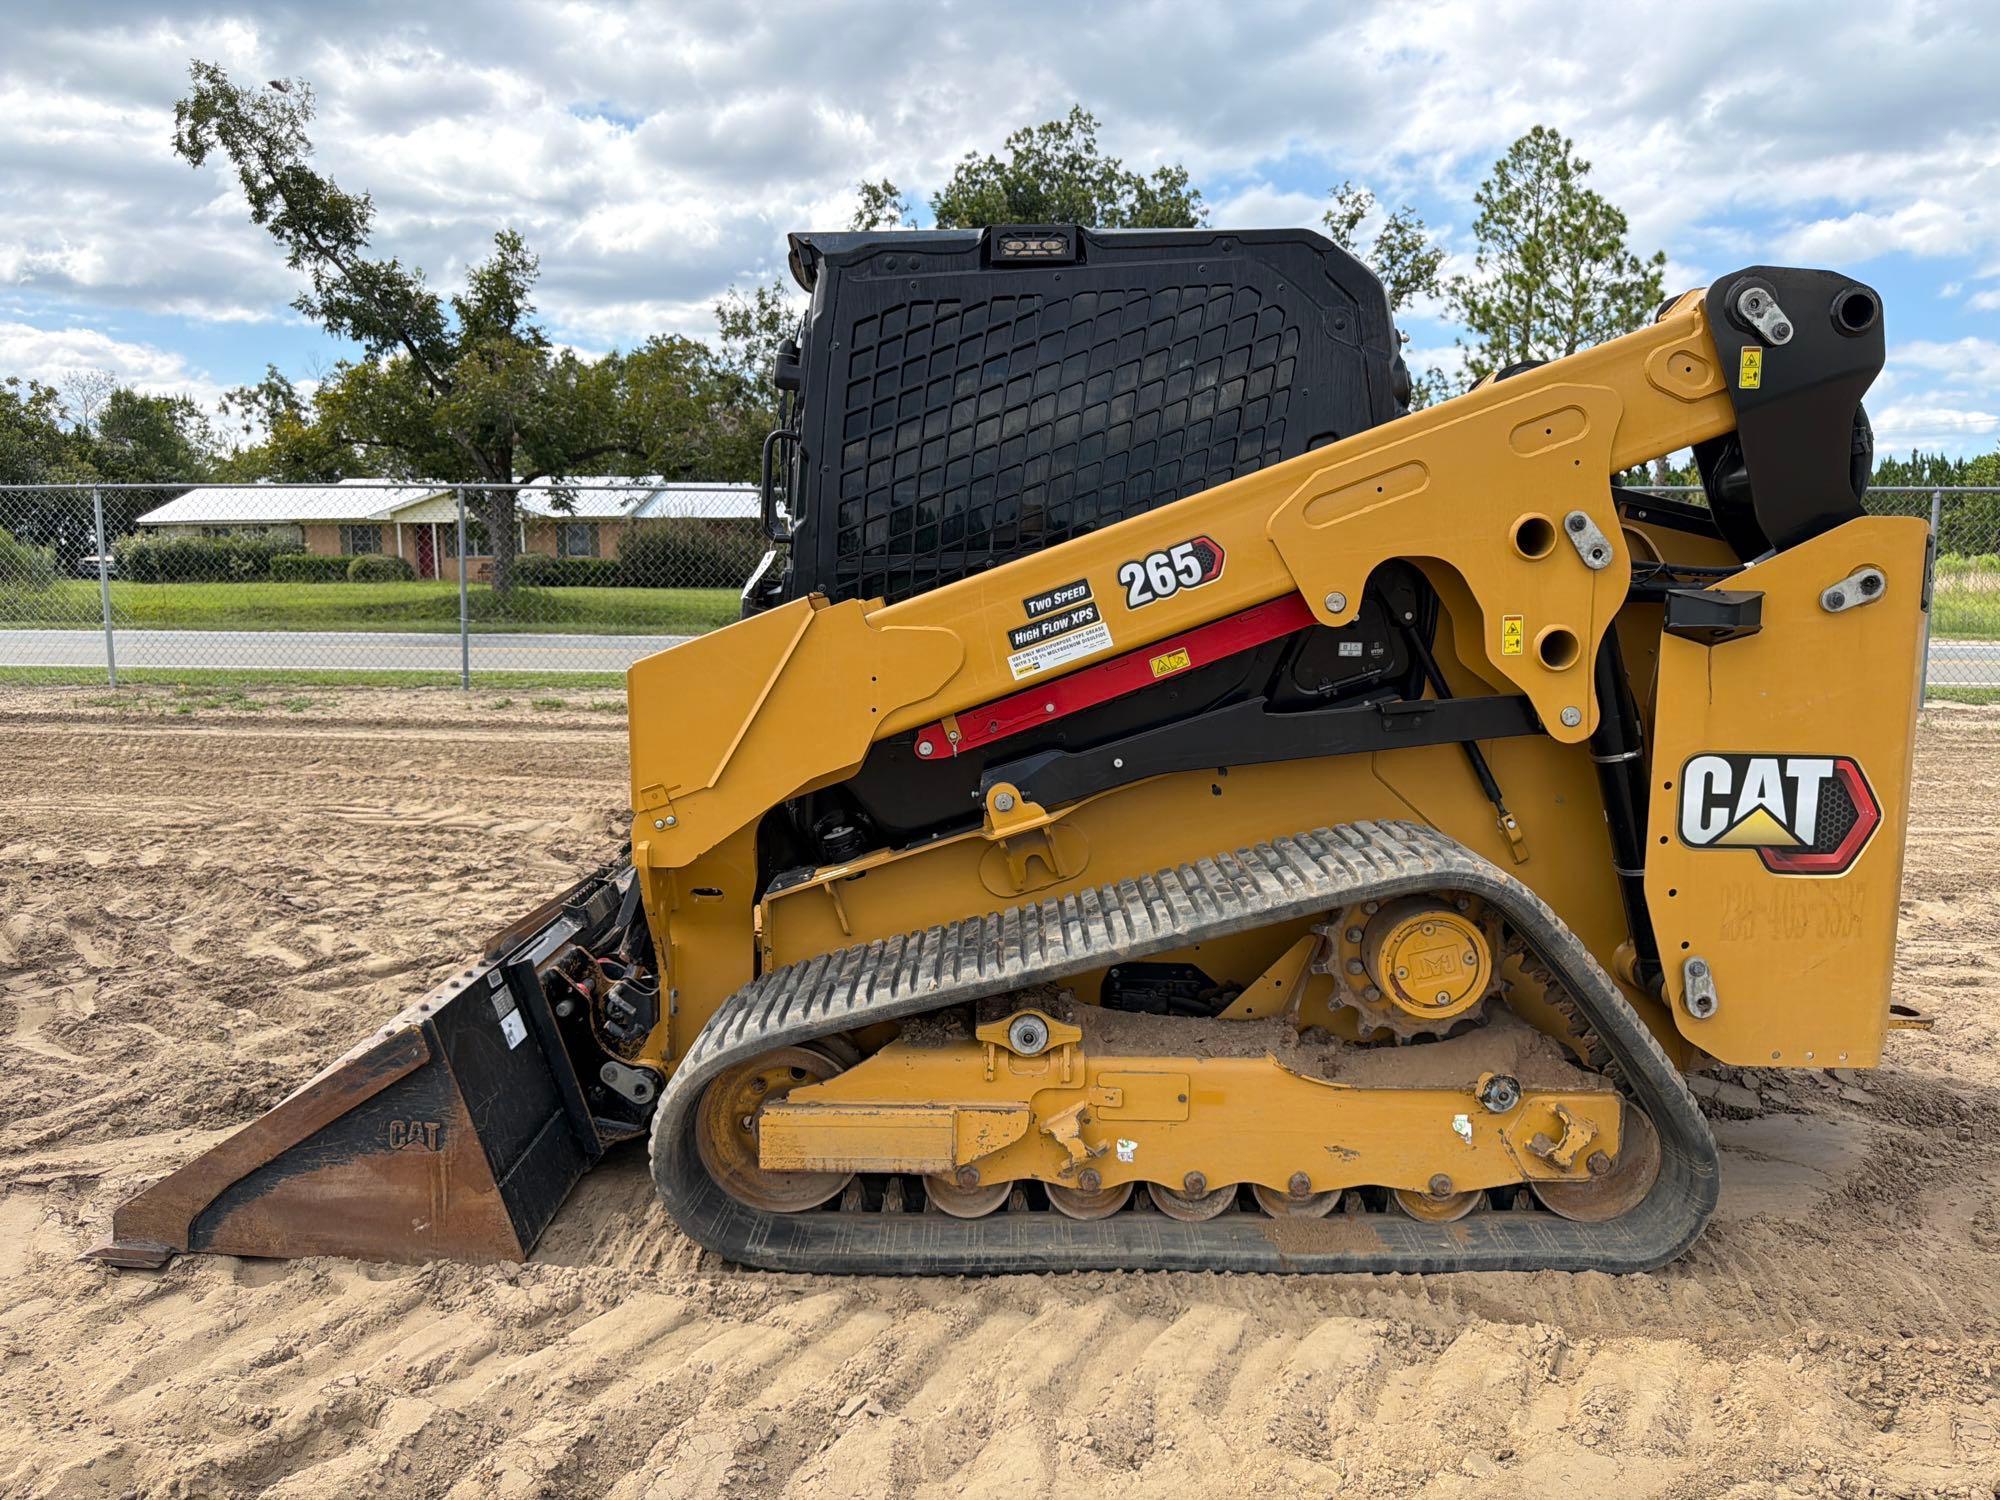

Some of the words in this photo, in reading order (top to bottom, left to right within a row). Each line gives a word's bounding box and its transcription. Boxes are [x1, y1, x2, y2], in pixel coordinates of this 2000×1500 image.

[1119, 542, 1202, 608] 265
[1028, 597, 1053, 615] TWO
[1054, 584, 1087, 606] SPEED
[1014, 627, 1040, 645] HIGH
[1041, 617, 1070, 637] FLOW
[1070, 607, 1094, 626] XPS
[1022, 651, 1035, 659] ONLY
[1035, 637, 1072, 654] MULTIPURPOSE
[1072, 633, 1083, 641] TYPE
[1085, 626, 1105, 635] GREASE
[1082, 632, 1106, 643] DISULFIDE
[1682, 755, 1834, 846] CAT
[389, 1119, 441, 1151] CAT
